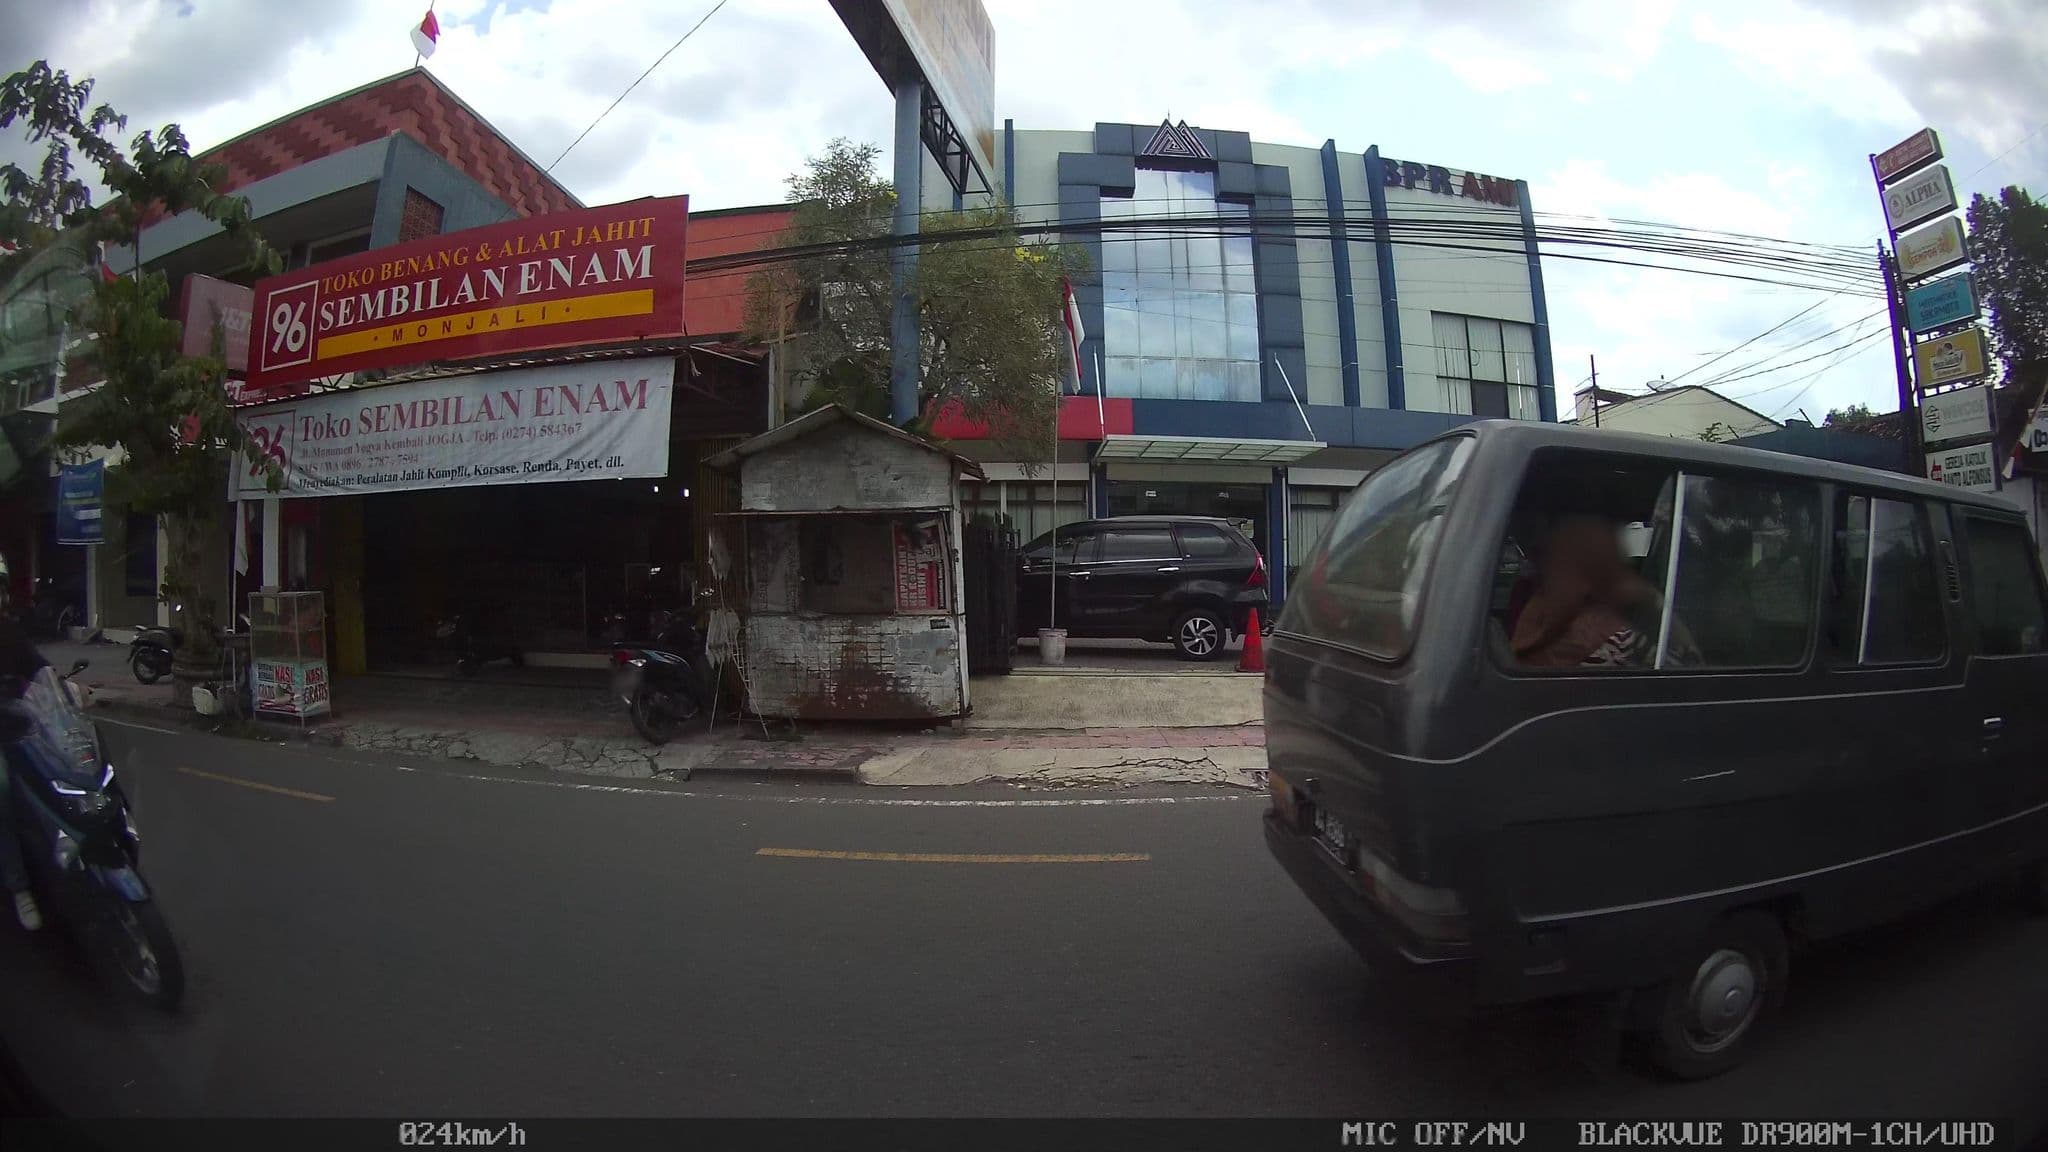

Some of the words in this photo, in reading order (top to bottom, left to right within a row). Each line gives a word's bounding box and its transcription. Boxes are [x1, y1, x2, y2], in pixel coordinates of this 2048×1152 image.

[1381, 157, 1454, 196] BPR
[1904, 181, 1942, 206] ALPHA
[322, 267, 375, 295] TOKO
[381, 247, 469, 281] BENANG
[475, 243, 492, 263] &
[499, 229, 566, 258] ALAT
[571, 217, 656, 247] JAHIT
[319, 266, 509, 332] SEMBILAN
[517, 245, 656, 295] ENAM
[272, 302, 306, 354] 96
[392, 306, 546, 342] MONJALI
[301, 413, 351, 442] Toko
[359, 389, 523, 435] SEMBILAN
[533, 379, 649, 418] ENAM
[313, 446, 353, 458] Monumen
[355, 443, 382, 454] Yogya
[384, 436, 424, 451] Kembali
[426, 433, 464, 446] JOGJA
[474, 430, 497, 445] Telp.
[502, 426, 536, 440] (0274)
[540, 422, 583, 438] 584367
[298, 475, 355, 490] Menyediakan:
[357, 473, 398, 485] Peralatan
[400, 469, 424, 481] Jahit
[427, 465, 471, 481] Komplit,
[523, 460, 562, 473] Renda,
[565, 457, 602, 473] Payet,
[606, 456, 624, 468] dll.
[1945, 455, 1964, 470] GEREJA
[1965, 450, 1987, 467] KATOLIK
[275, 664, 293, 684] NASI
[305, 667, 323, 683] NASI
[304, 681, 328, 704] GRATIS
